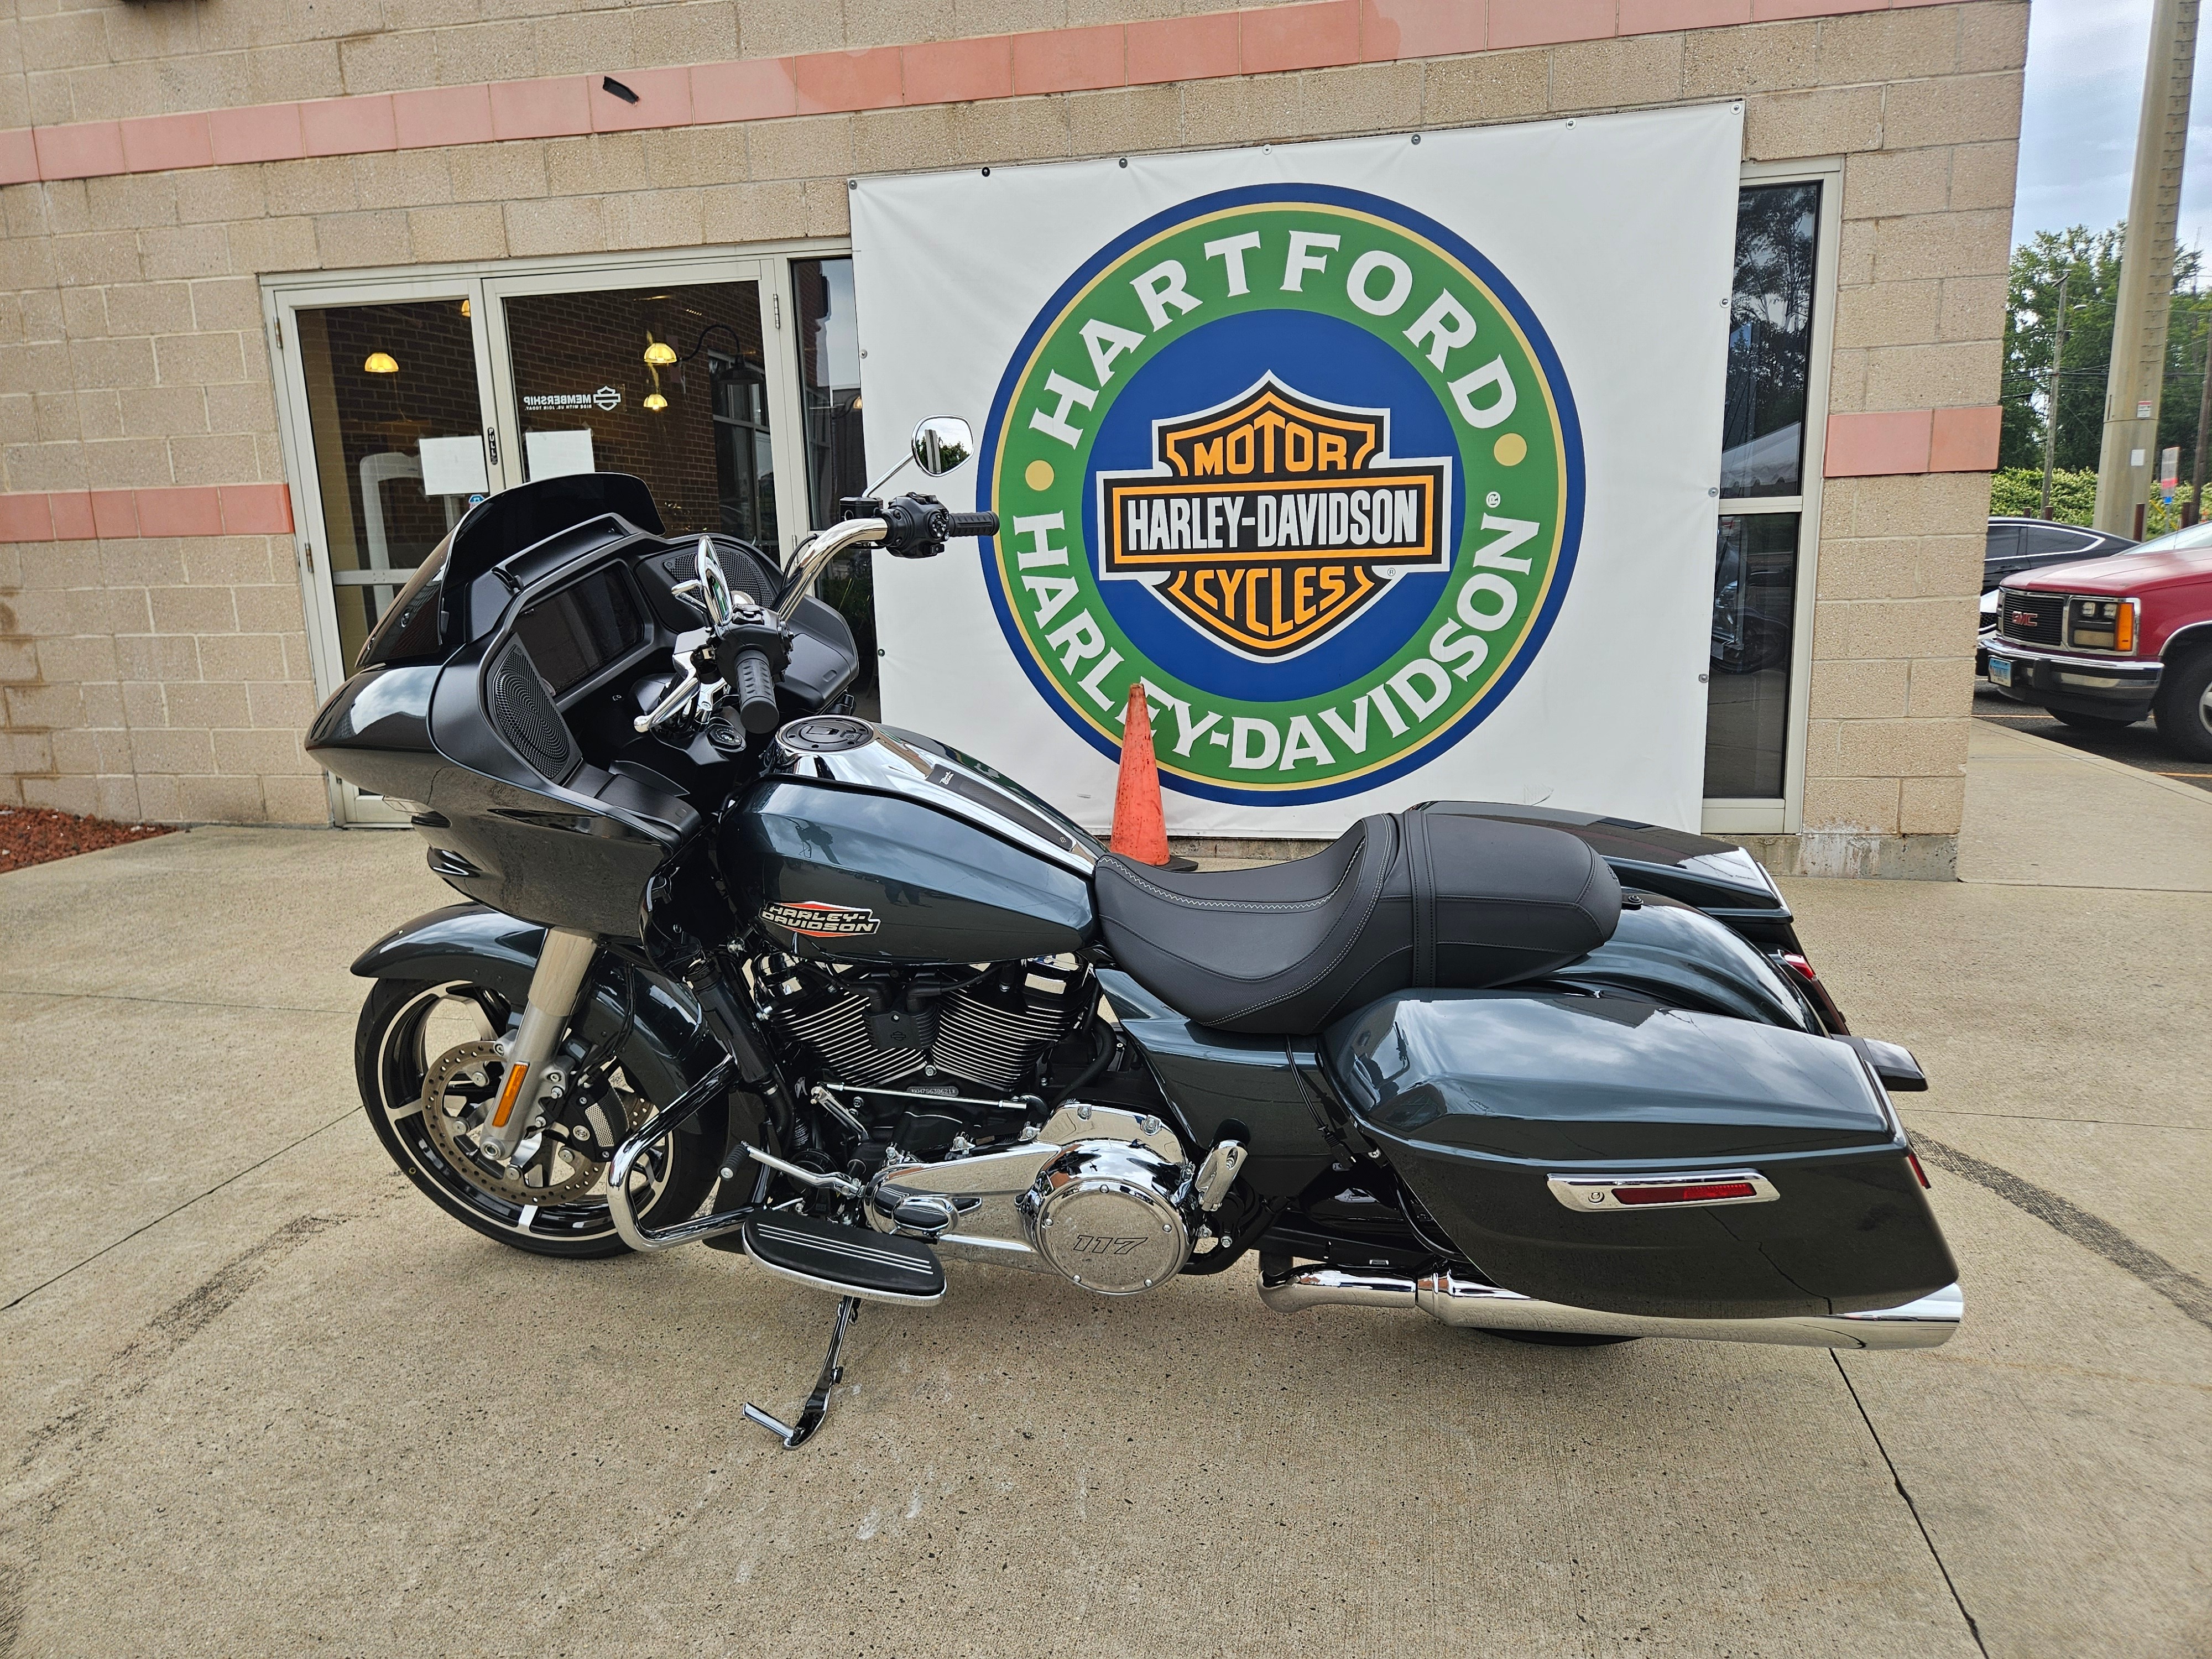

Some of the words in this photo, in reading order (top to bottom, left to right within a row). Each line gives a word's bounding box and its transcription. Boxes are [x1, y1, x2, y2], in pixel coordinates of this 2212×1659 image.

[1029, 231, 1516, 450] HARTFORD
[1195, 411, 1345, 474] MOTOR
[1128, 489, 1417, 550] HARLEY-DAVIDSON
[1195, 567, 1344, 635] CYCLES
[2012, 611, 2038, 627] GMC
[761, 911, 874, 931] DAVIDSON
[769, 905, 866, 922] HARLEY-
[1073, 1234, 1148, 1255] 117
